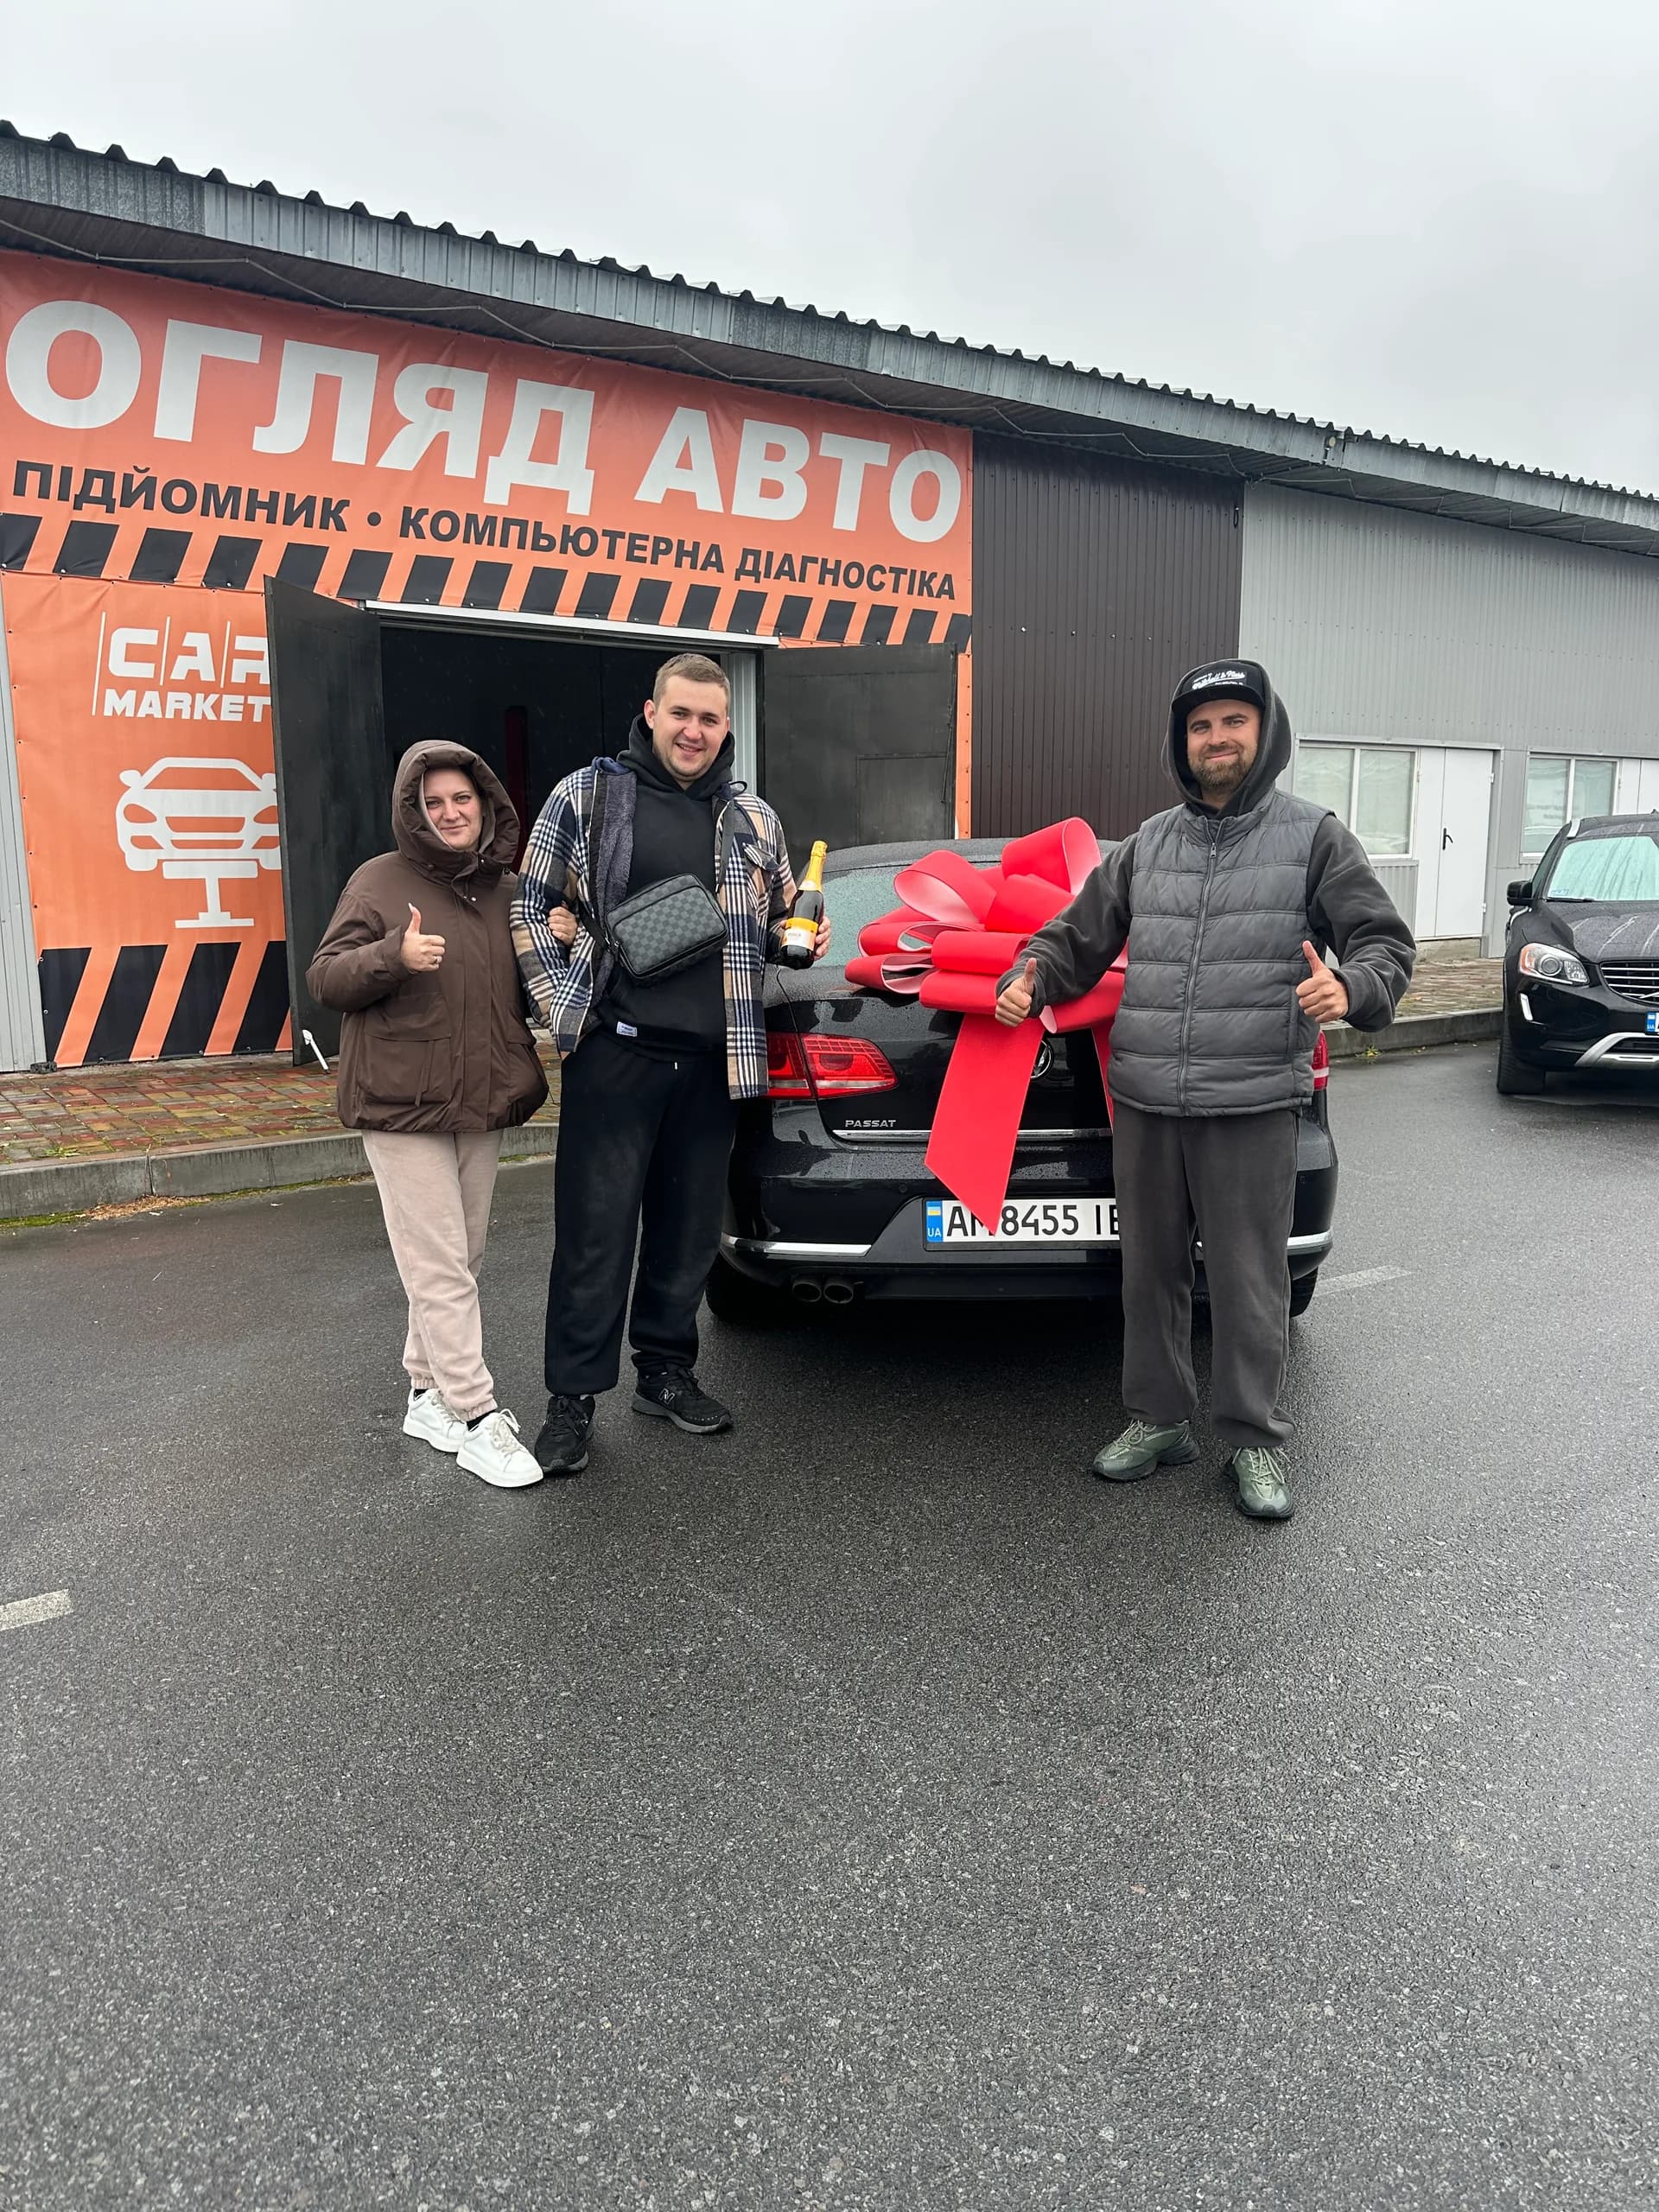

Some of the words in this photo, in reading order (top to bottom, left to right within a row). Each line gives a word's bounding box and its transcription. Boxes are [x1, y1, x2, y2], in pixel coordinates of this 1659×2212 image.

[6, 300, 594, 516] ОГЛЯД
[634, 406, 962, 543] АВТО
[13, 460, 350, 531] ПІДЙОМНИК
[399, 505, 725, 574] КОМПЬЮТЕРНА
[734, 548, 956, 601] ДІАГНОСТІКА
[108, 627, 270, 685] CAR
[103, 689, 271, 722] MARKET
[927, 1228, 942, 1237] UA
[1001, 1205, 1079, 1236] 8455
